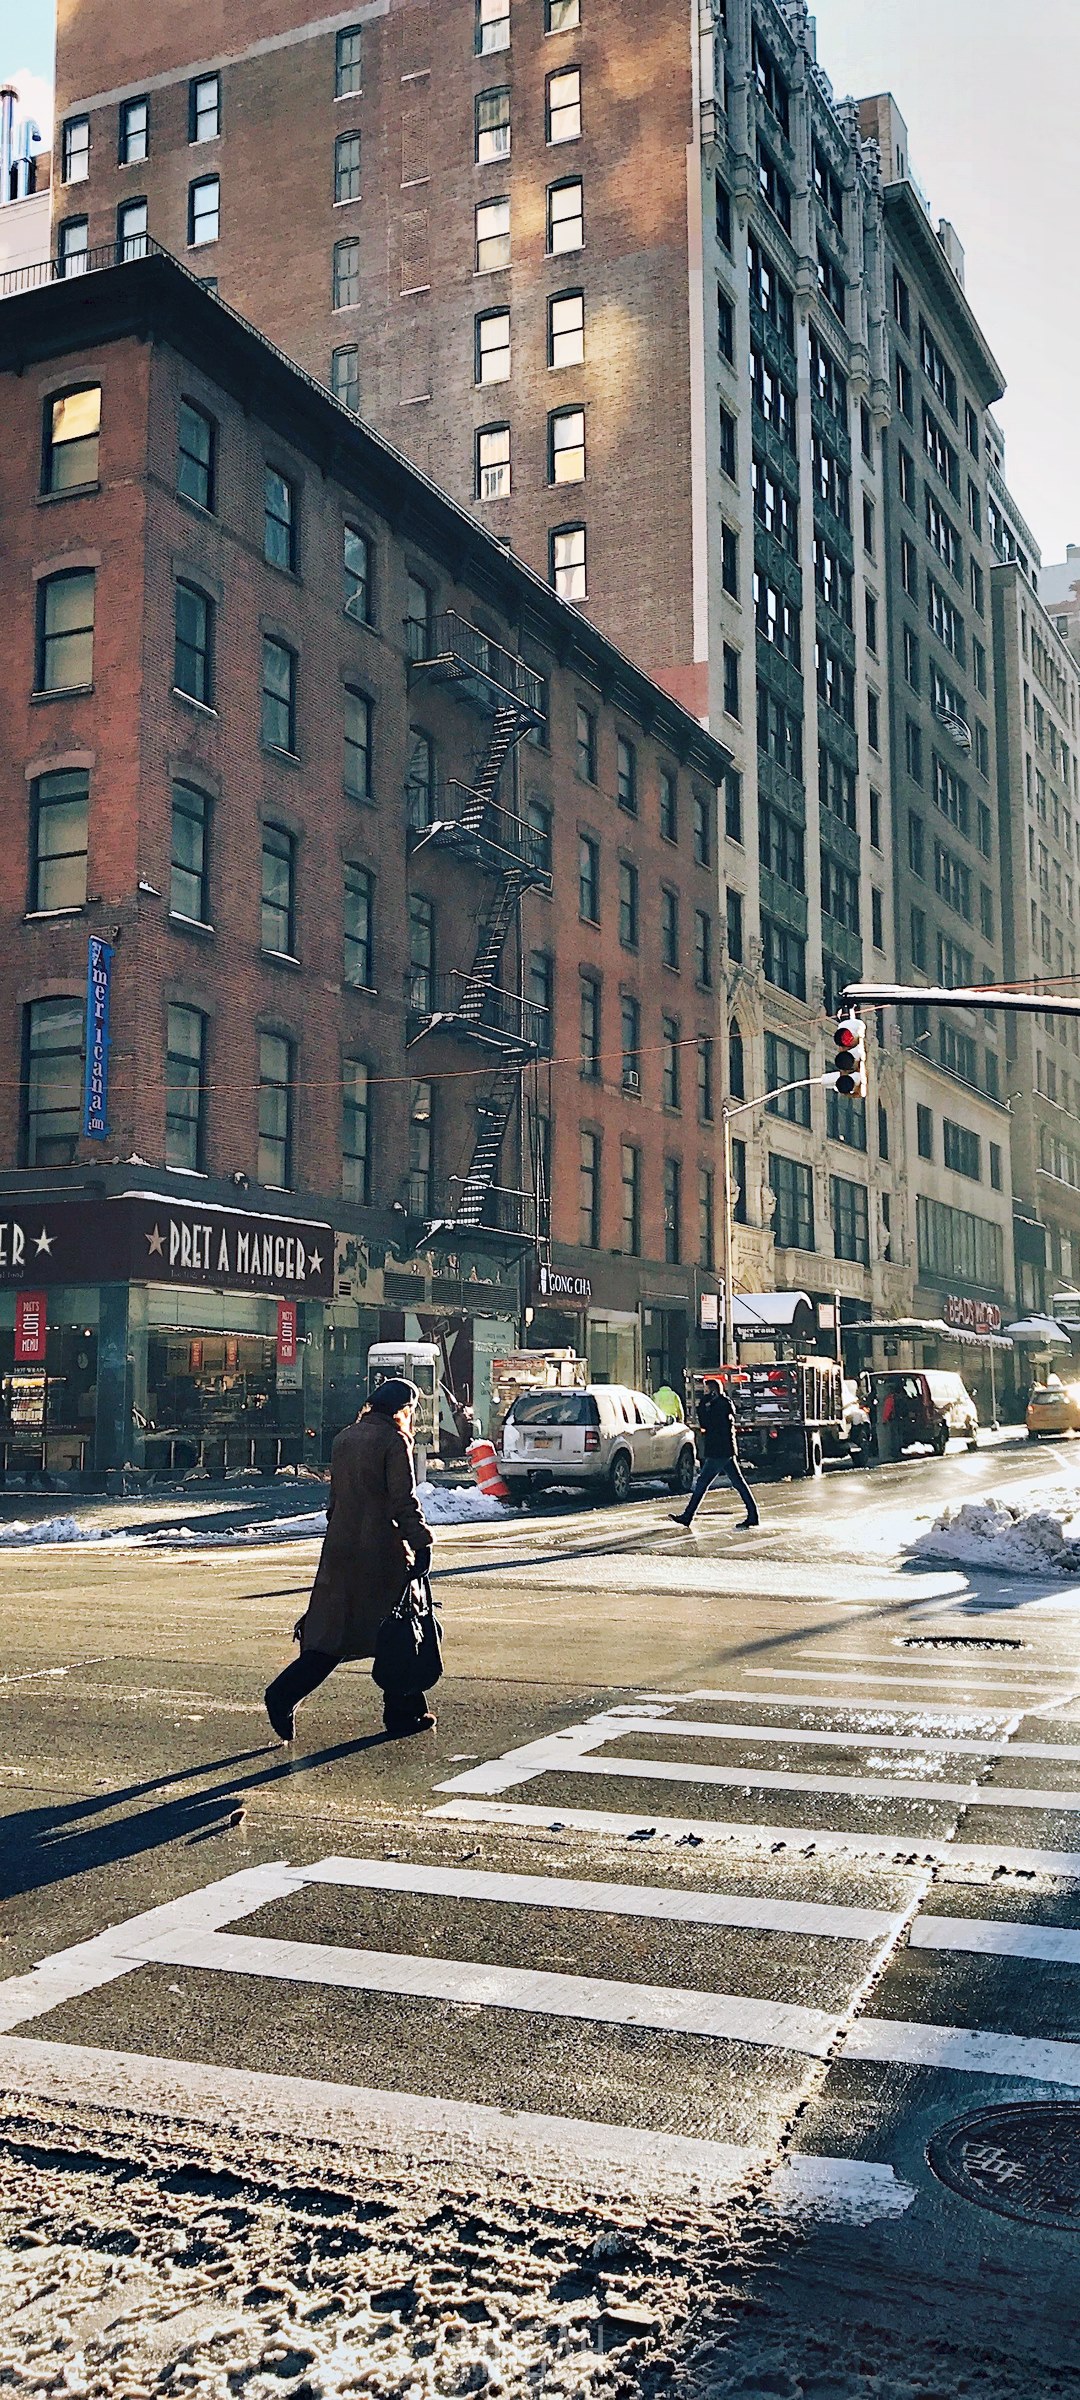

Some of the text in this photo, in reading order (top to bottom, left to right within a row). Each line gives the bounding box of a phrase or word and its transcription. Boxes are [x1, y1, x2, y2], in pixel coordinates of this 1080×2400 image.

[169, 1219, 213, 1270] PRET
[217, 1227, 230, 1272] A
[236, 1230, 306, 1281] MANGER
[549, 1274, 592, 1296] GONG CHA
[22, 1313, 40, 1337] HOT
[281, 1321, 293, 1344] HOT
[21, 1338, 39, 1352] MENU
